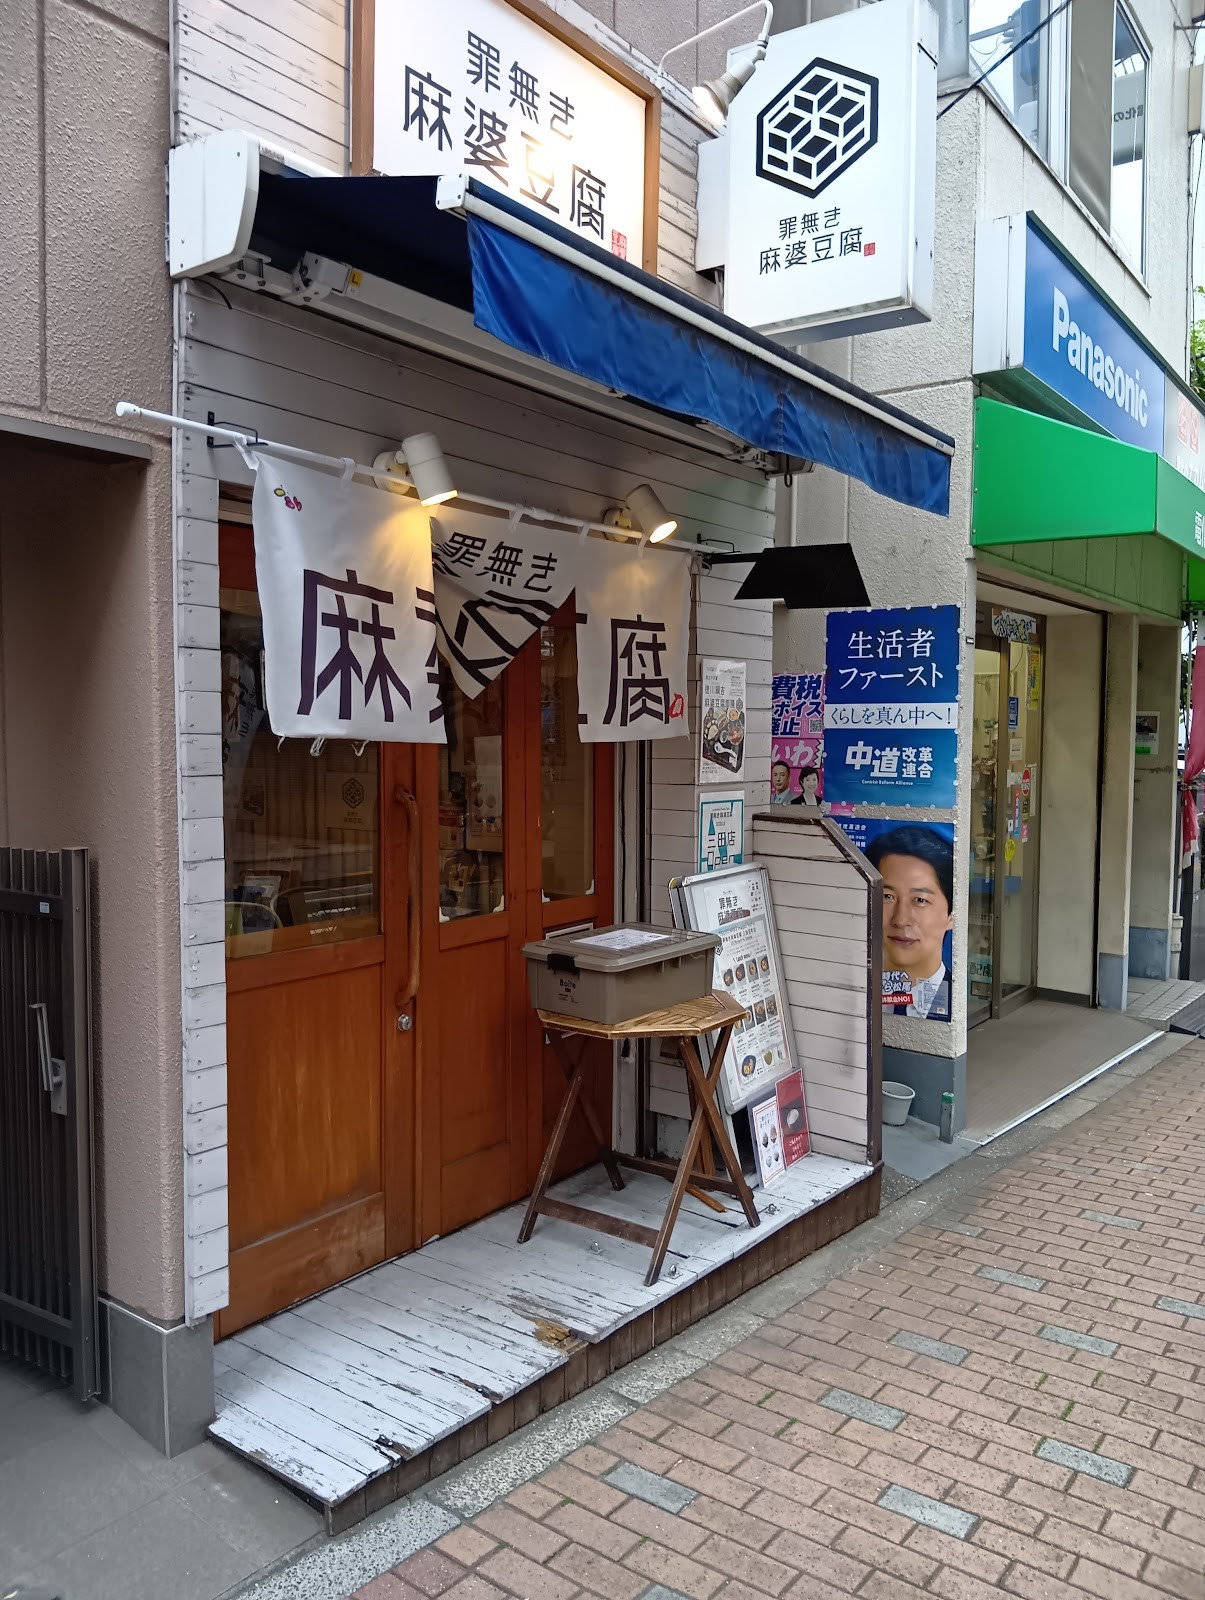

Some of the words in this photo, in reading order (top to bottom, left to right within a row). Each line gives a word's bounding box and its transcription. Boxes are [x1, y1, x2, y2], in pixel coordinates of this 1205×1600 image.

[466, 30, 575, 142] 罪無き
[402, 64, 607, 241] 麻婆豆腐
[779, 206, 841, 240] 罪無き
[759, 227, 863, 275] 麻婆豆腐
[1053, 286, 1148, 428] Panasonic
[437, 531, 558, 593] 罪無き
[847, 628, 936, 660] 生活者
[838, 662, 944, 690] ファースト
[772, 700, 822, 717] ボイス
[829, 706, 952, 726] くらしを真ん中へ！
[845, 740, 901, 778] 中道
[901, 747, 933, 762] 改革
[901, 763, 934, 778] 連合
[838, 823, 867, 831] 改革連合
